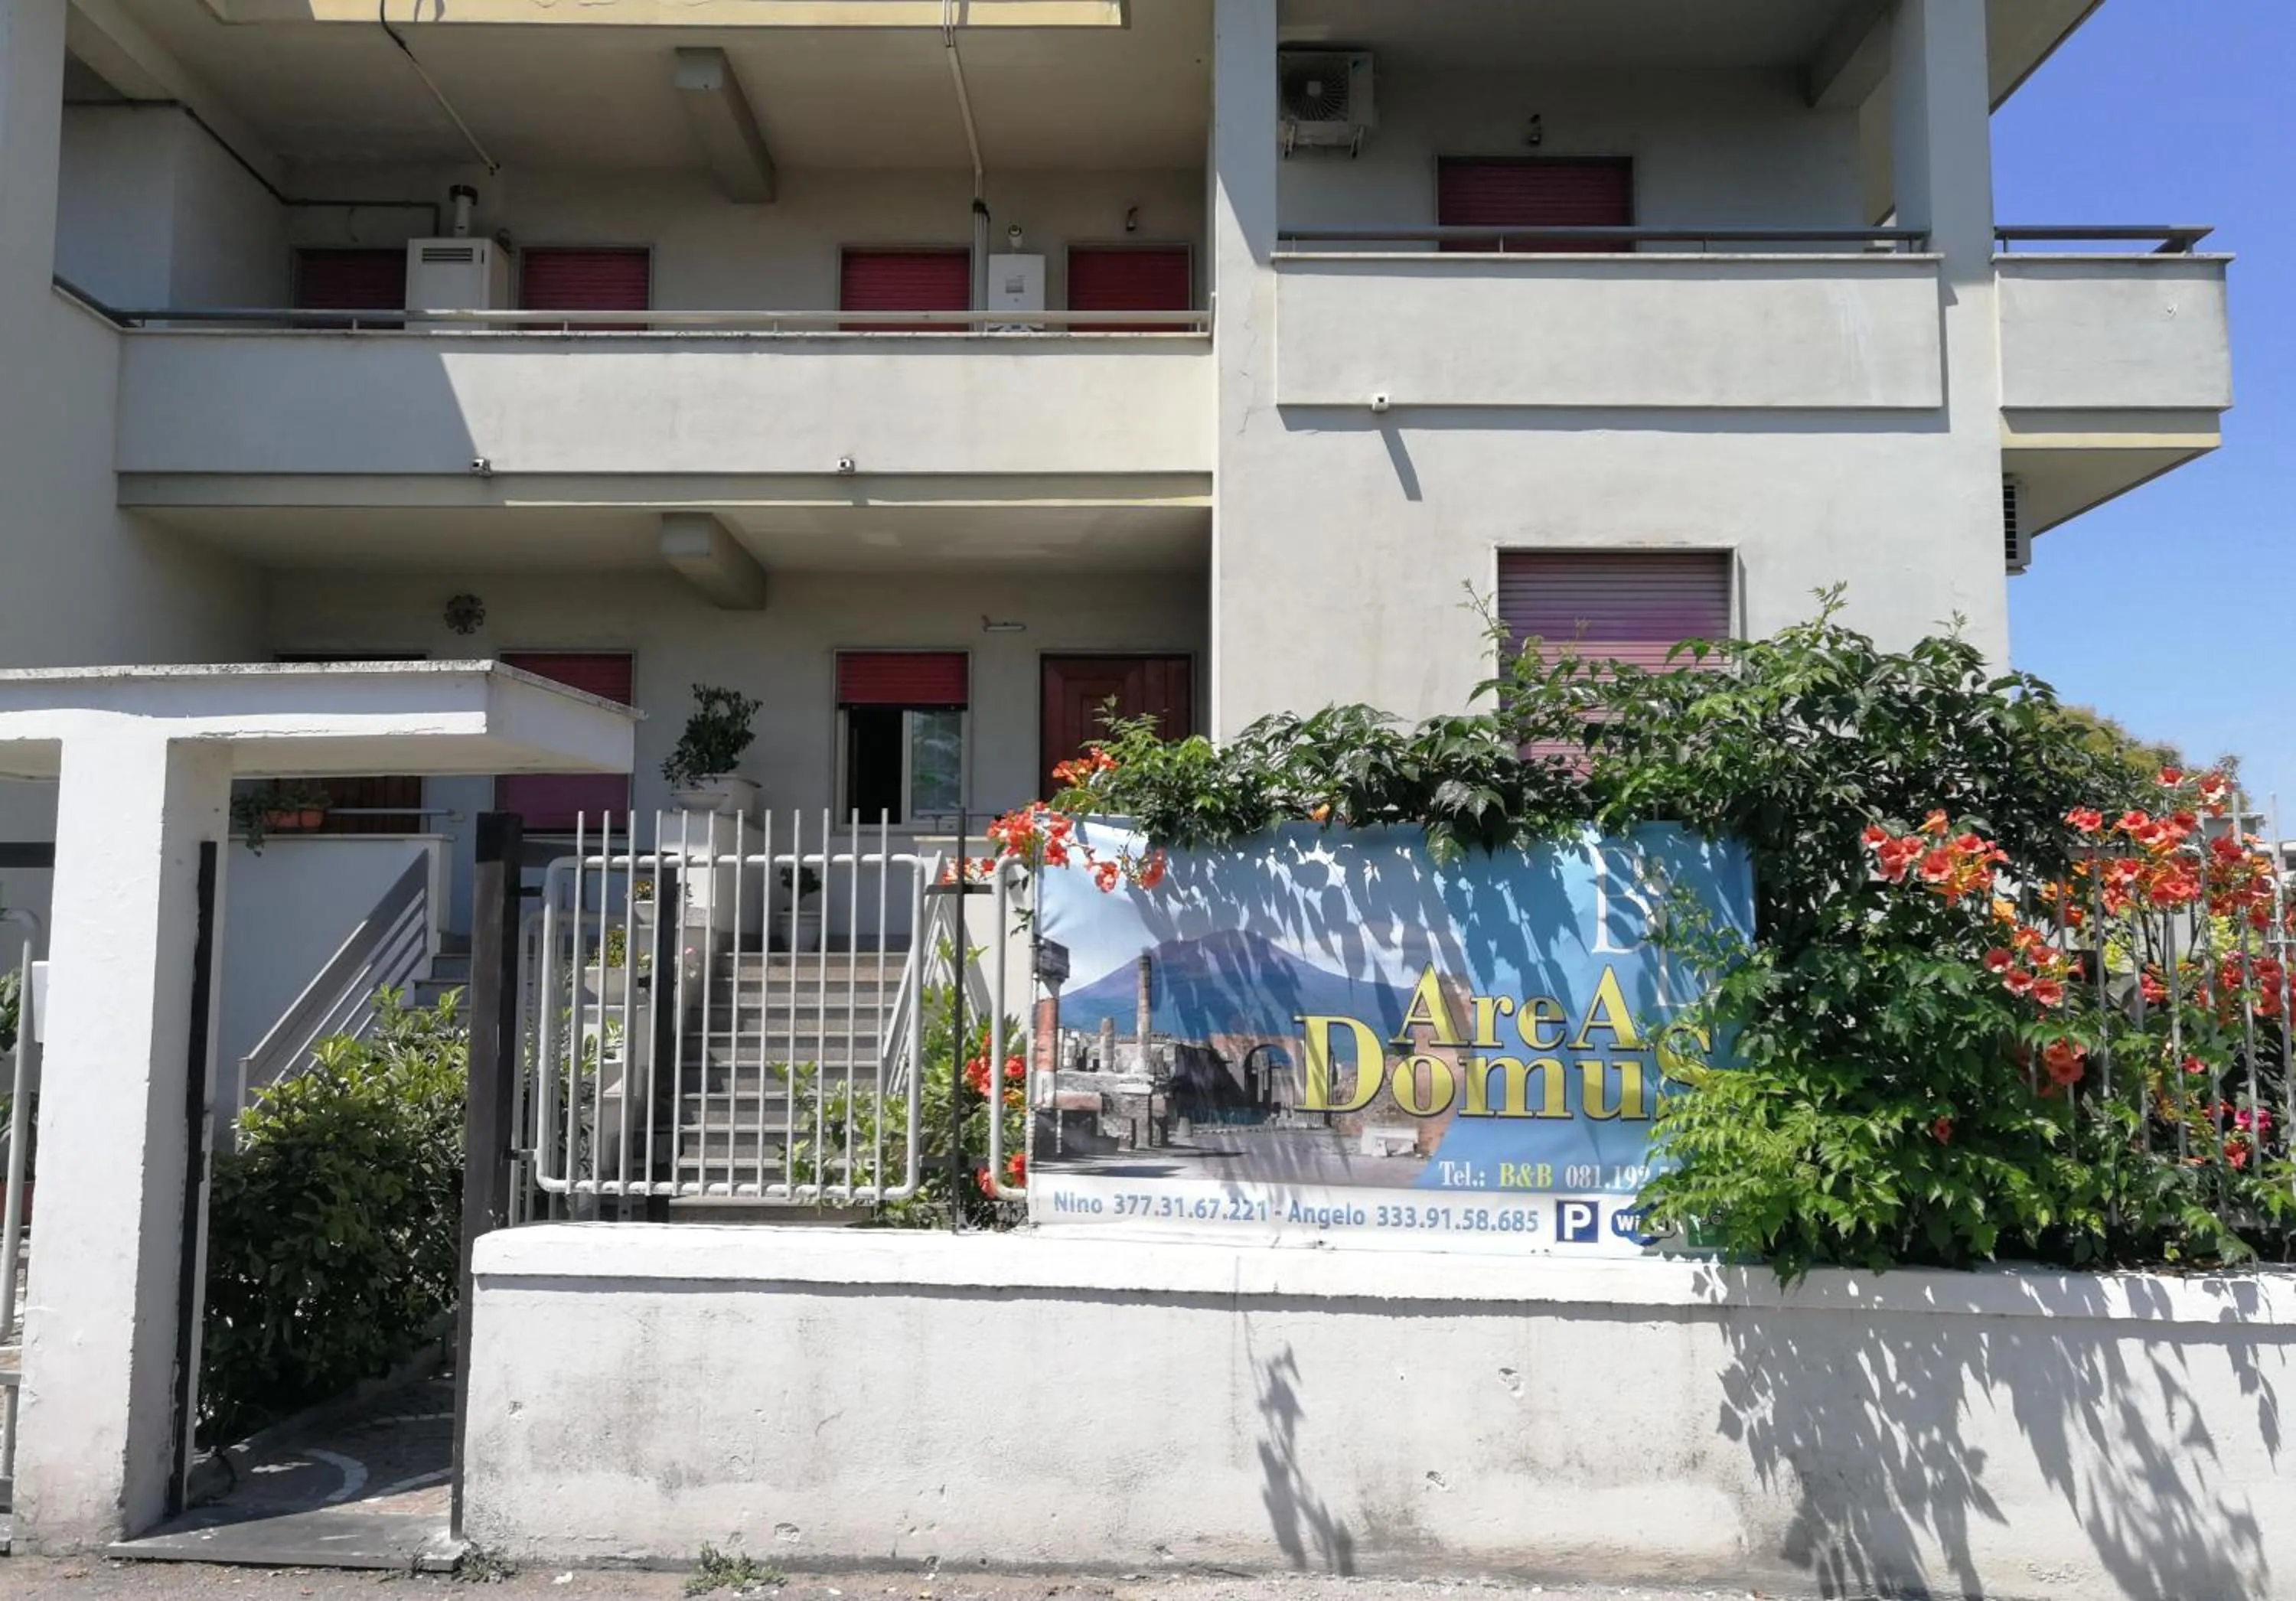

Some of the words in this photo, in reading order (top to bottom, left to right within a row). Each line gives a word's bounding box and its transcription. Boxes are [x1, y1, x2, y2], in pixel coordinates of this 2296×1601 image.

[1388, 961, 1650, 1052] AreA
[1439, 1160, 1486, 1187] Tel.:
[1499, 1162, 1553, 1189] B&B
[1054, 1191, 1103, 1215] Nino
[1114, 1194, 1267, 1222] 377.31.67.221
[1287, 1198, 1366, 1230] Angelo
[1377, 1205, 1539, 1233] 333.91.58.685
